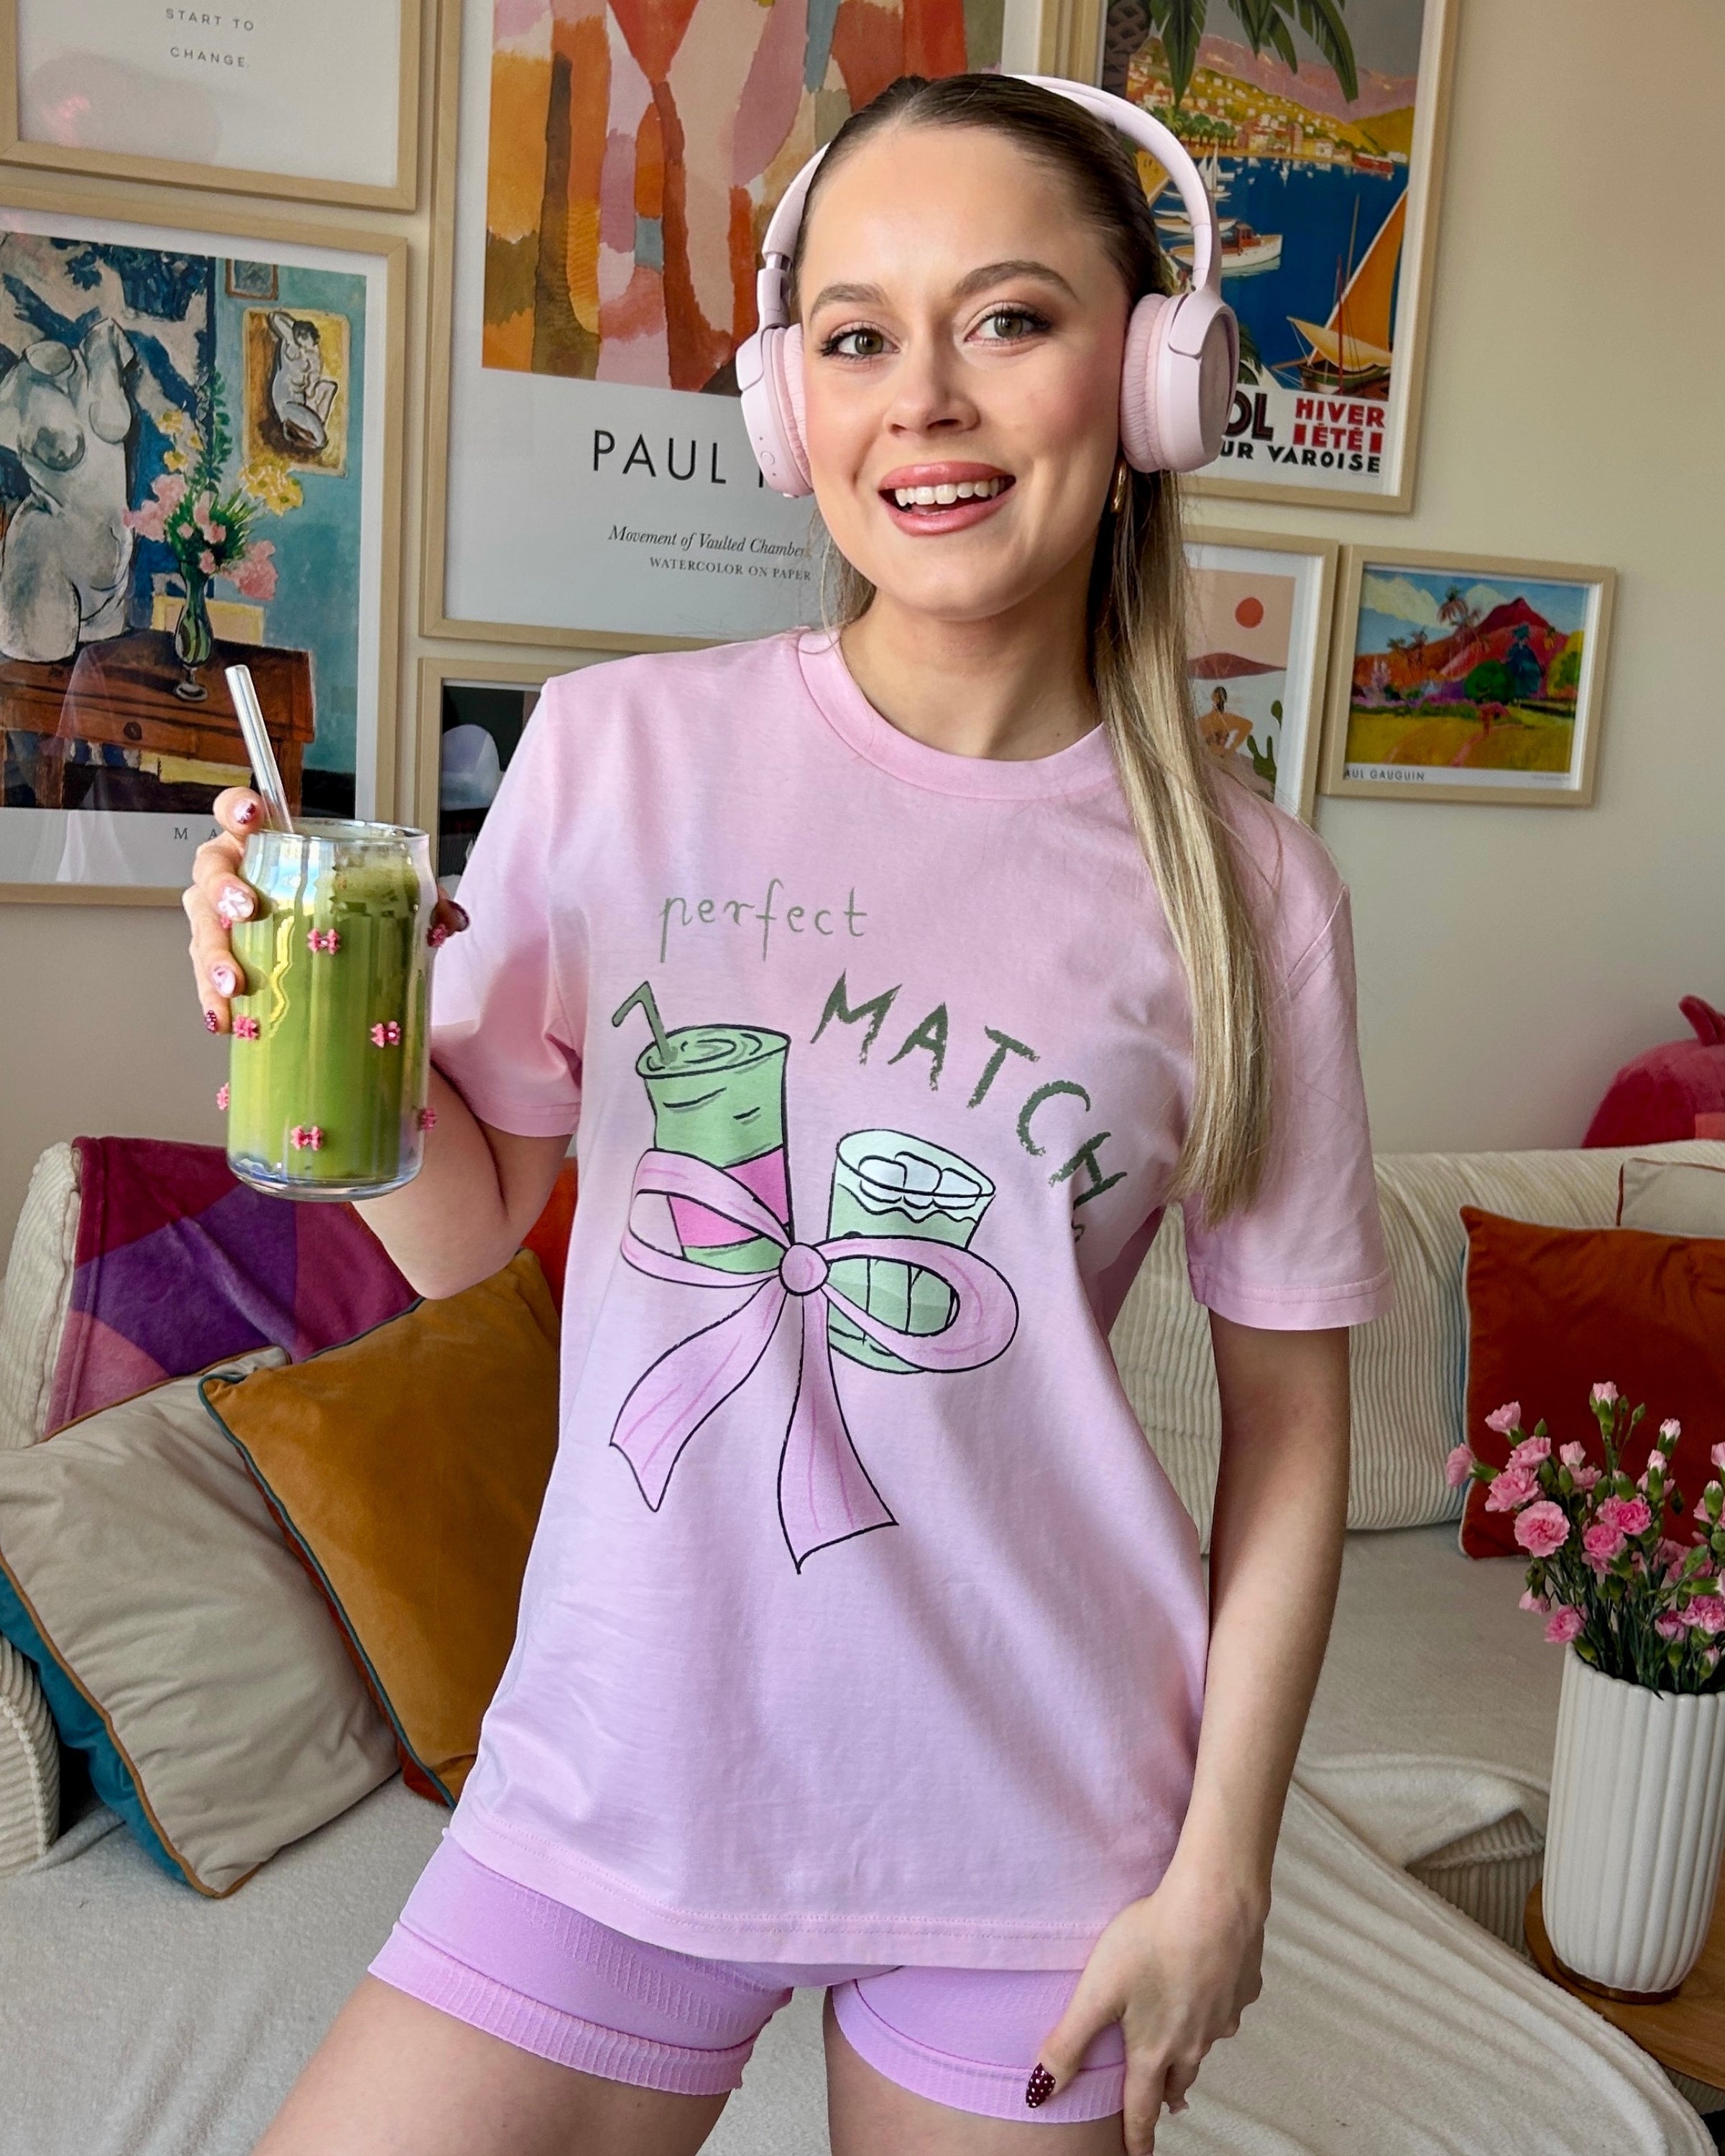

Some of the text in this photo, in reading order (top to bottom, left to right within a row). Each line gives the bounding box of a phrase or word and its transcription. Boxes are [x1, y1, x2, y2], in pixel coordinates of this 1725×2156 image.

[166, 8, 254, 31] START TO
[1296, 397, 1385, 428] HIVER
[594, 430, 726, 484] PAUL
[1268, 445, 1381, 474] VAROISE
[609, 525, 677, 546] Movement
[681, 533, 697, 552] of
[699, 533, 745, 553] Vaulted
[649, 557, 811, 581] WATERCOLOR ON PAPER
[1369, 768, 1425, 781] GAUGUIN
[660, 878, 868, 963] perfect
[810, 967, 1128, 1242] MATCH
